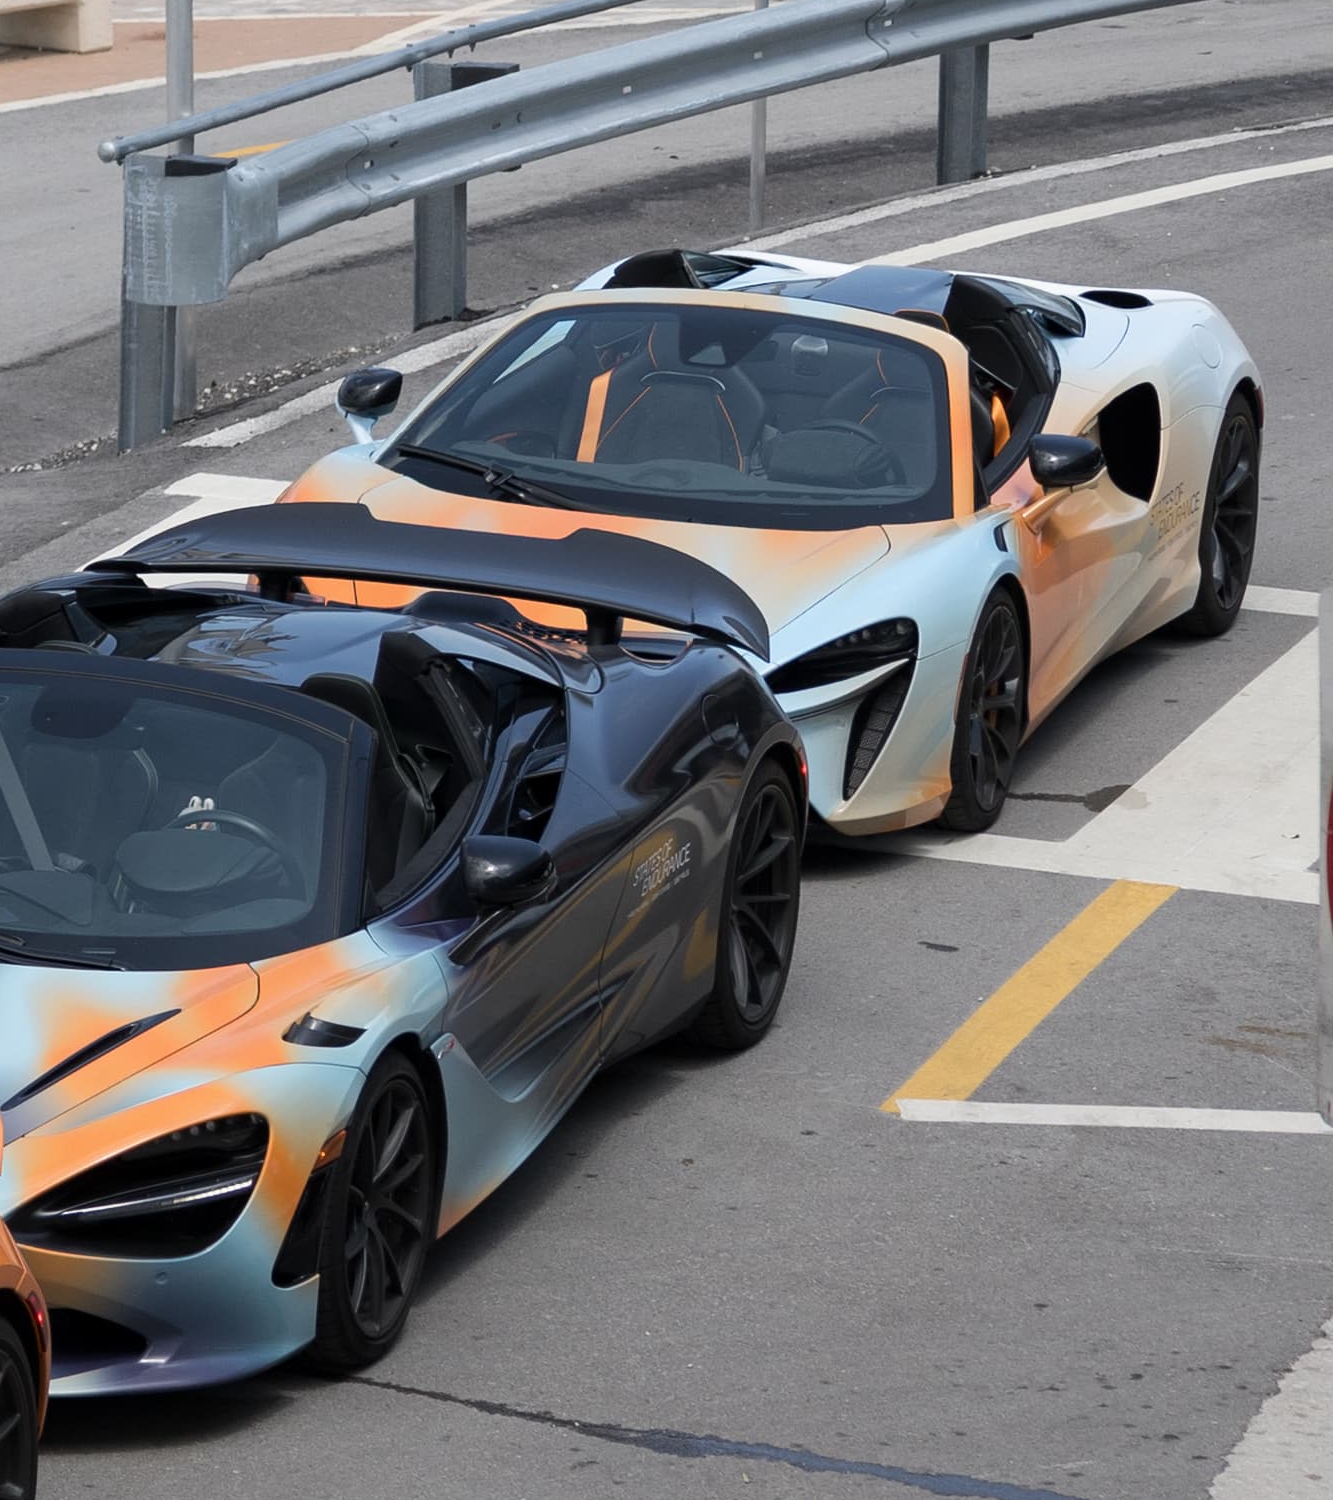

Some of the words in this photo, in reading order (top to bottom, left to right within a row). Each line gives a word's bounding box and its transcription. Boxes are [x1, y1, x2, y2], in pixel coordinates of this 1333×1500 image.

[632, 847, 663, 888] STATES
[661, 838, 674, 862] OF
[641, 841, 691, 897] ENDURANCE
